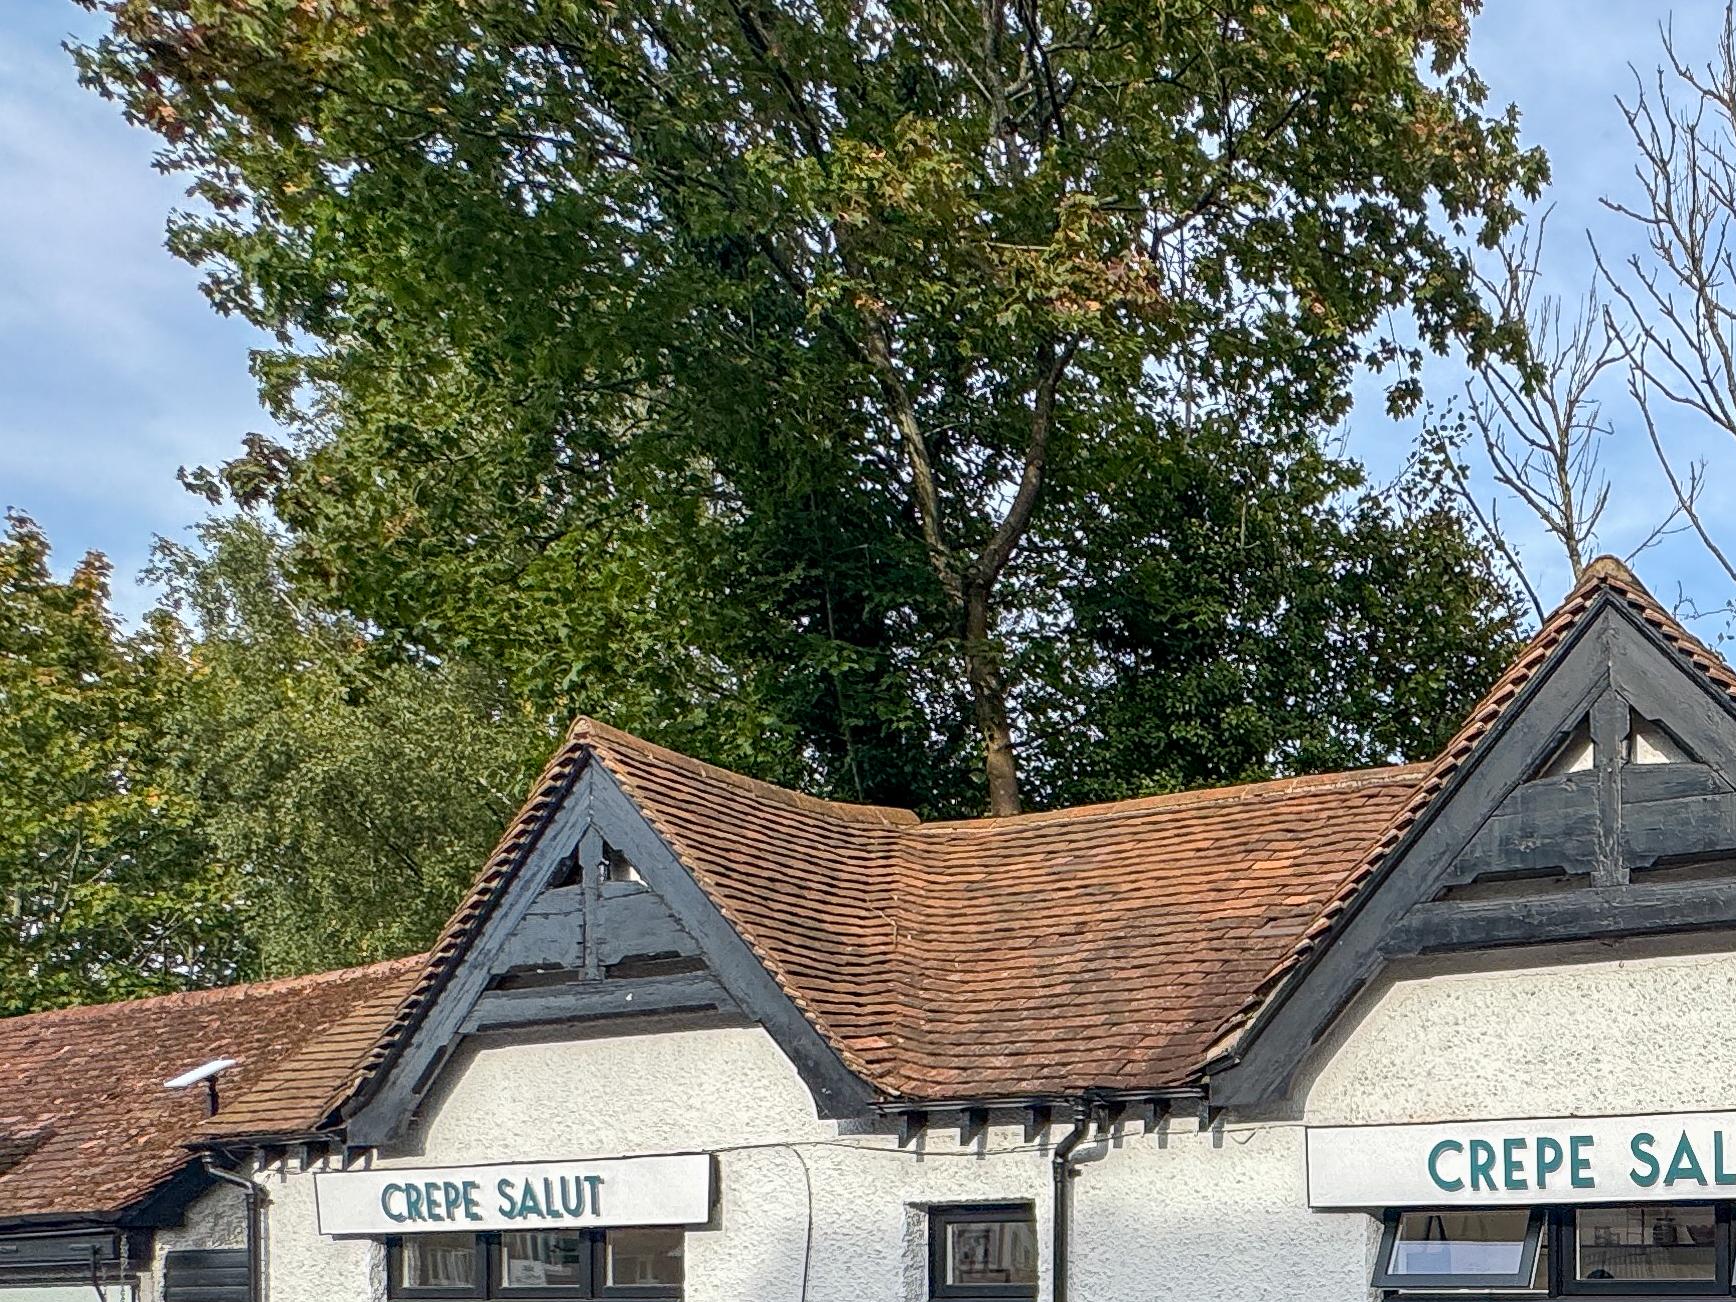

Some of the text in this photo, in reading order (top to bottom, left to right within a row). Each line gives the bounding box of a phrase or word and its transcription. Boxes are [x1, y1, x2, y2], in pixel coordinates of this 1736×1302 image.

[1427, 1135, 1597, 1193] CREPE
[381, 1175, 605, 1223] CREPE SALUT
